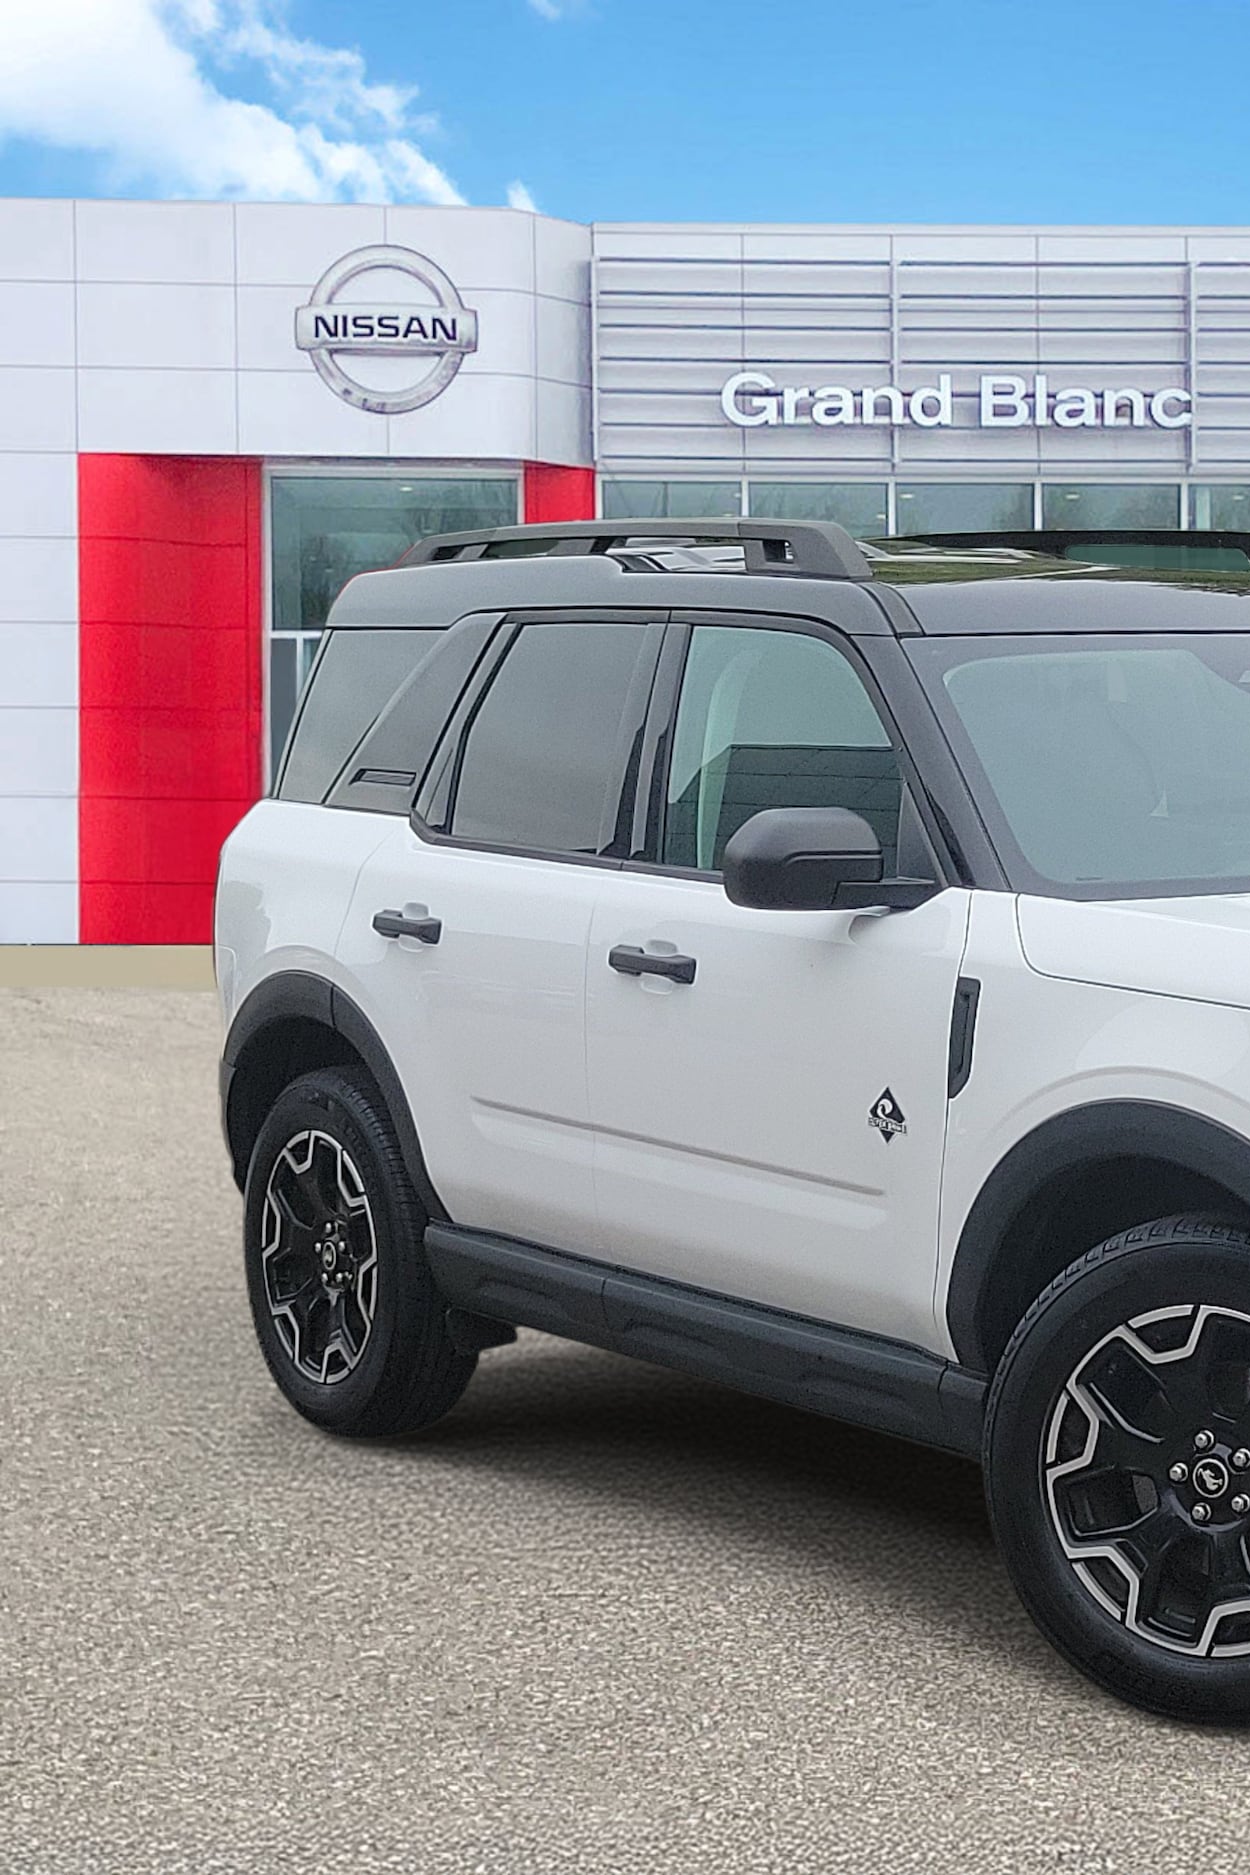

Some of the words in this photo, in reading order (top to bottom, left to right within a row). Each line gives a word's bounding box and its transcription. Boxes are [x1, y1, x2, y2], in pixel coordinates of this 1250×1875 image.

[314, 314, 457, 341] NISSAN
[721, 372, 952, 427] Grand
[980, 374, 1192, 428] Blanc
